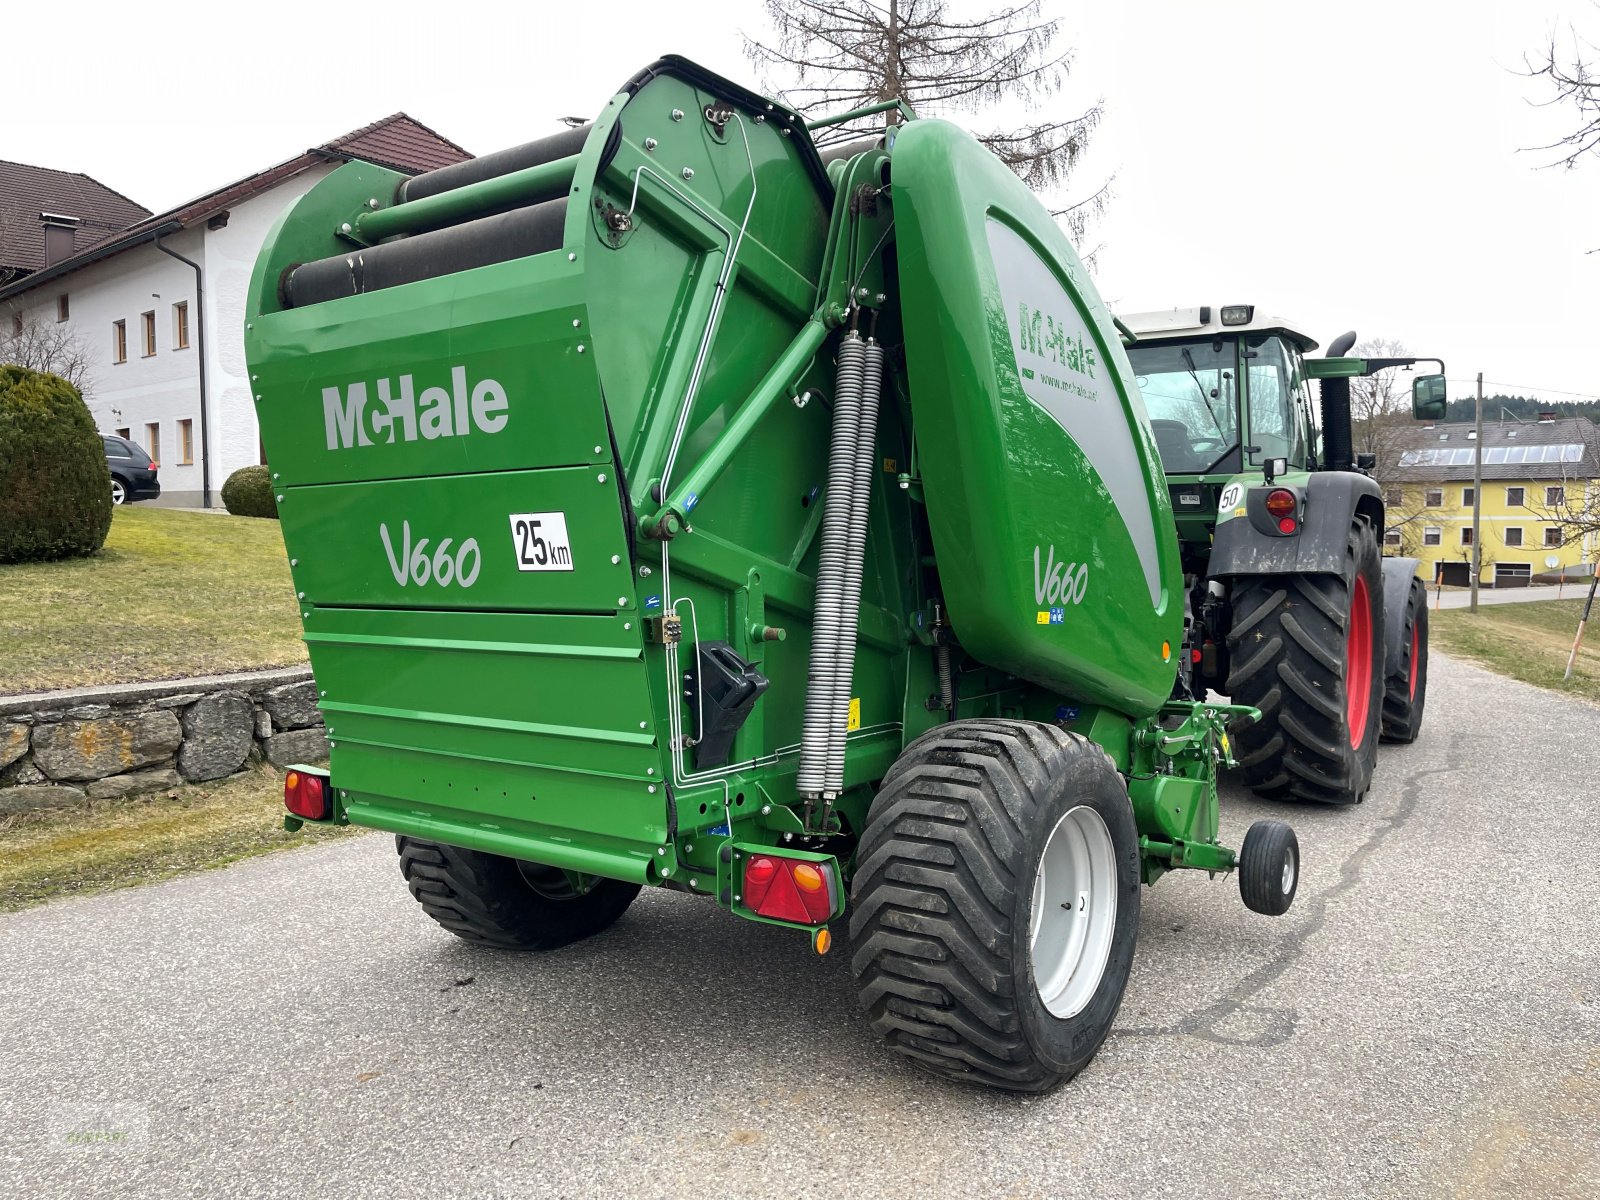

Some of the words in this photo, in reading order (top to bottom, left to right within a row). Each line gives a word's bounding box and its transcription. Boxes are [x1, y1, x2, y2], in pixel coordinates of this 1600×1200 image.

[321, 365, 509, 451] McHale
[1221, 487, 1239, 509] 50
[379, 520, 481, 588] V660
[1033, 544, 1089, 606] V660
